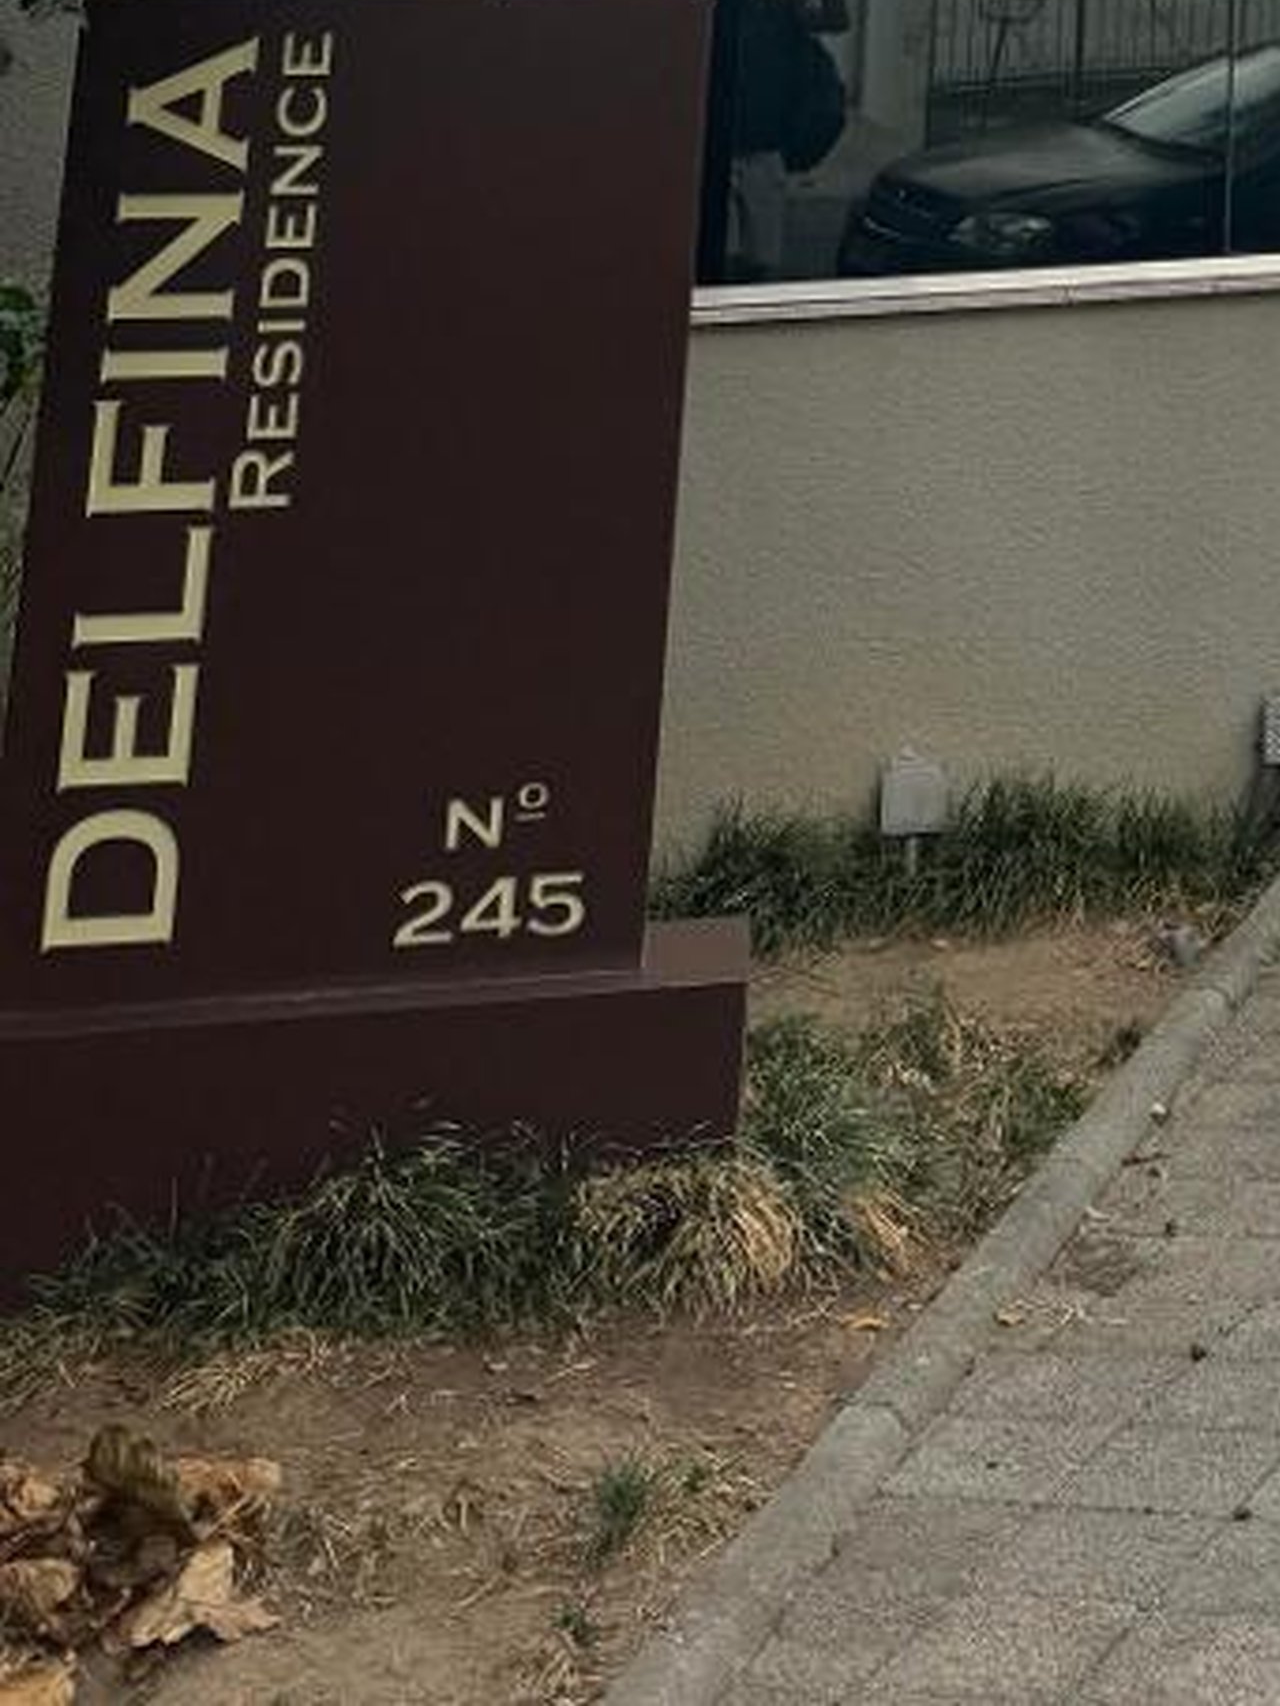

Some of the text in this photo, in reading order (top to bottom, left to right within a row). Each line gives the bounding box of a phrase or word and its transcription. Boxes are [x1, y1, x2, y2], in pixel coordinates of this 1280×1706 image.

[40, 36, 260, 953] DELFINA
[227, 32, 333, 510] RESIDENCE
[392, 871, 586, 947] 245
